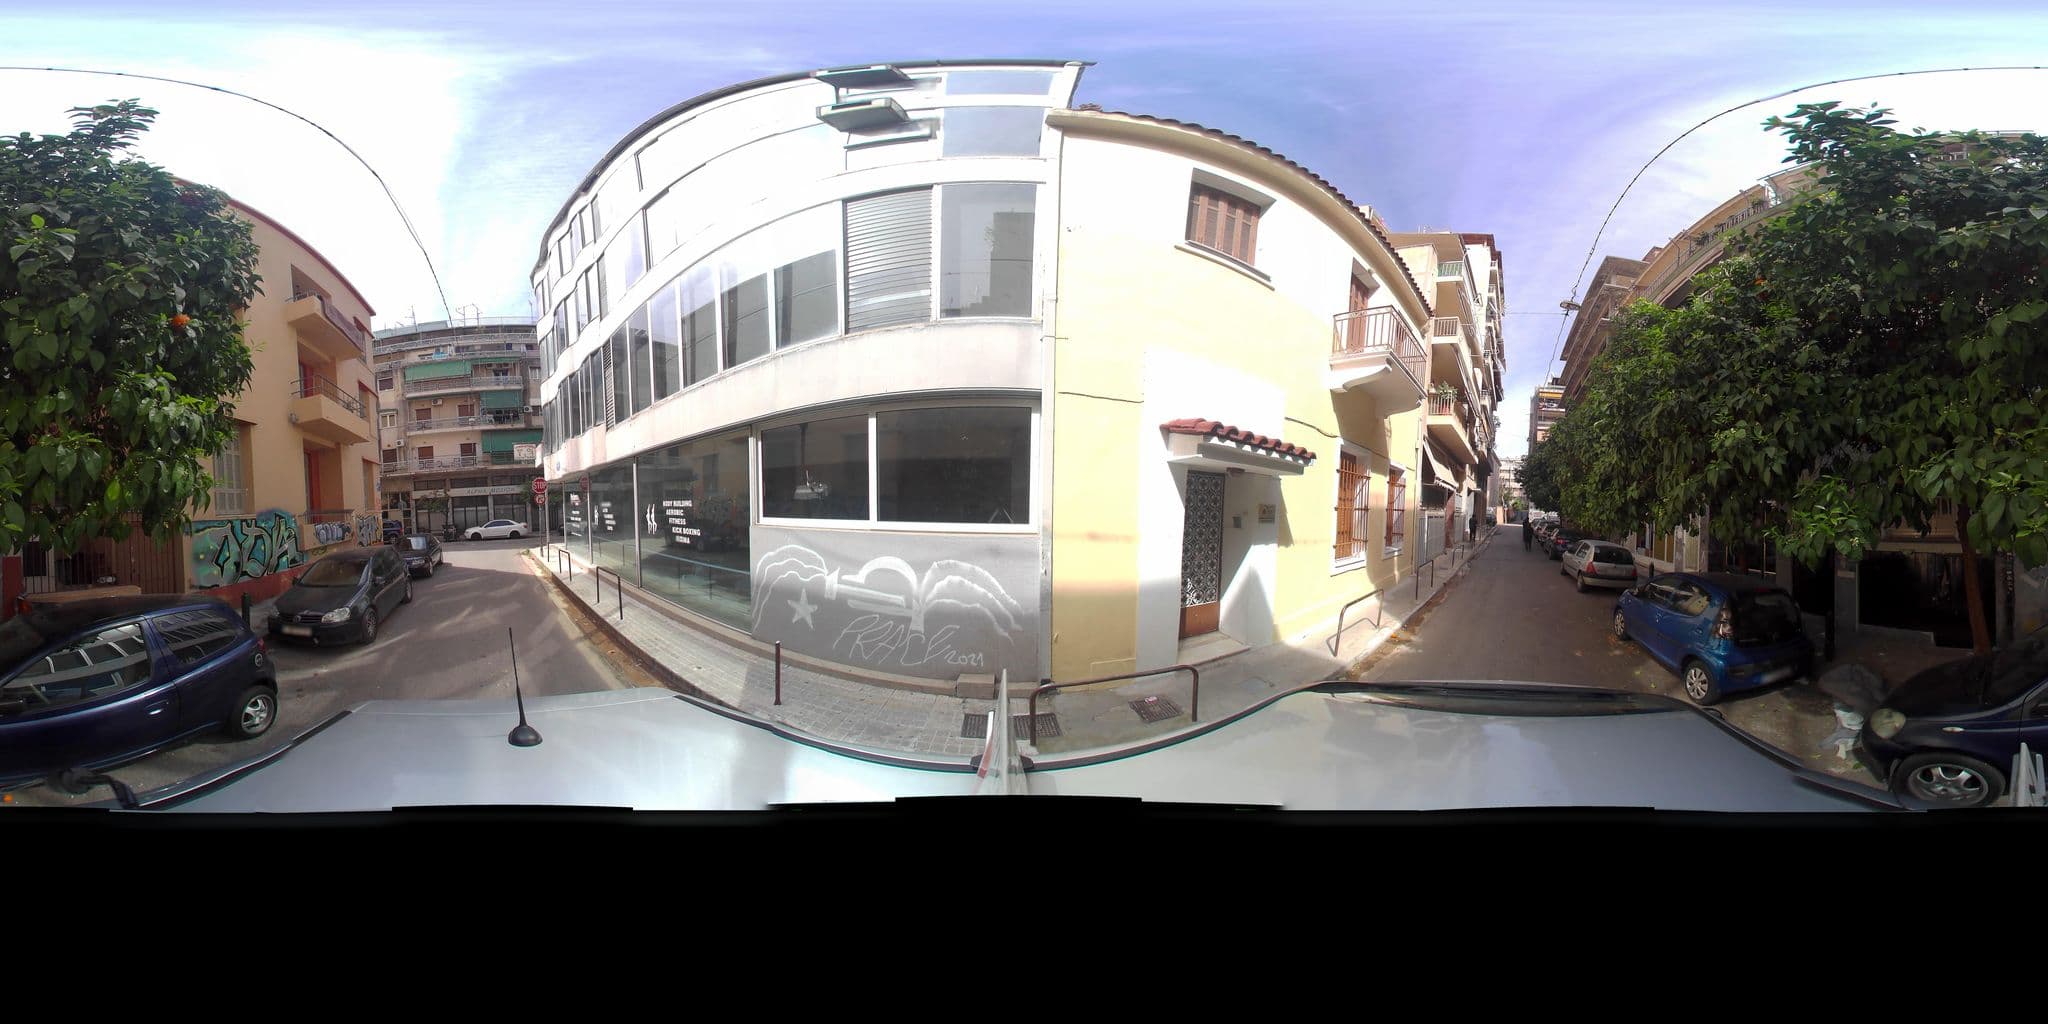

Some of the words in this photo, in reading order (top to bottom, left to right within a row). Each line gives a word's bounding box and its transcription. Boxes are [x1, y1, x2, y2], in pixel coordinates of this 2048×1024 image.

[534, 481, 546, 489] STOP
[683, 528, 700, 536] BOXING
[944, 650, 983, 667] 2021
